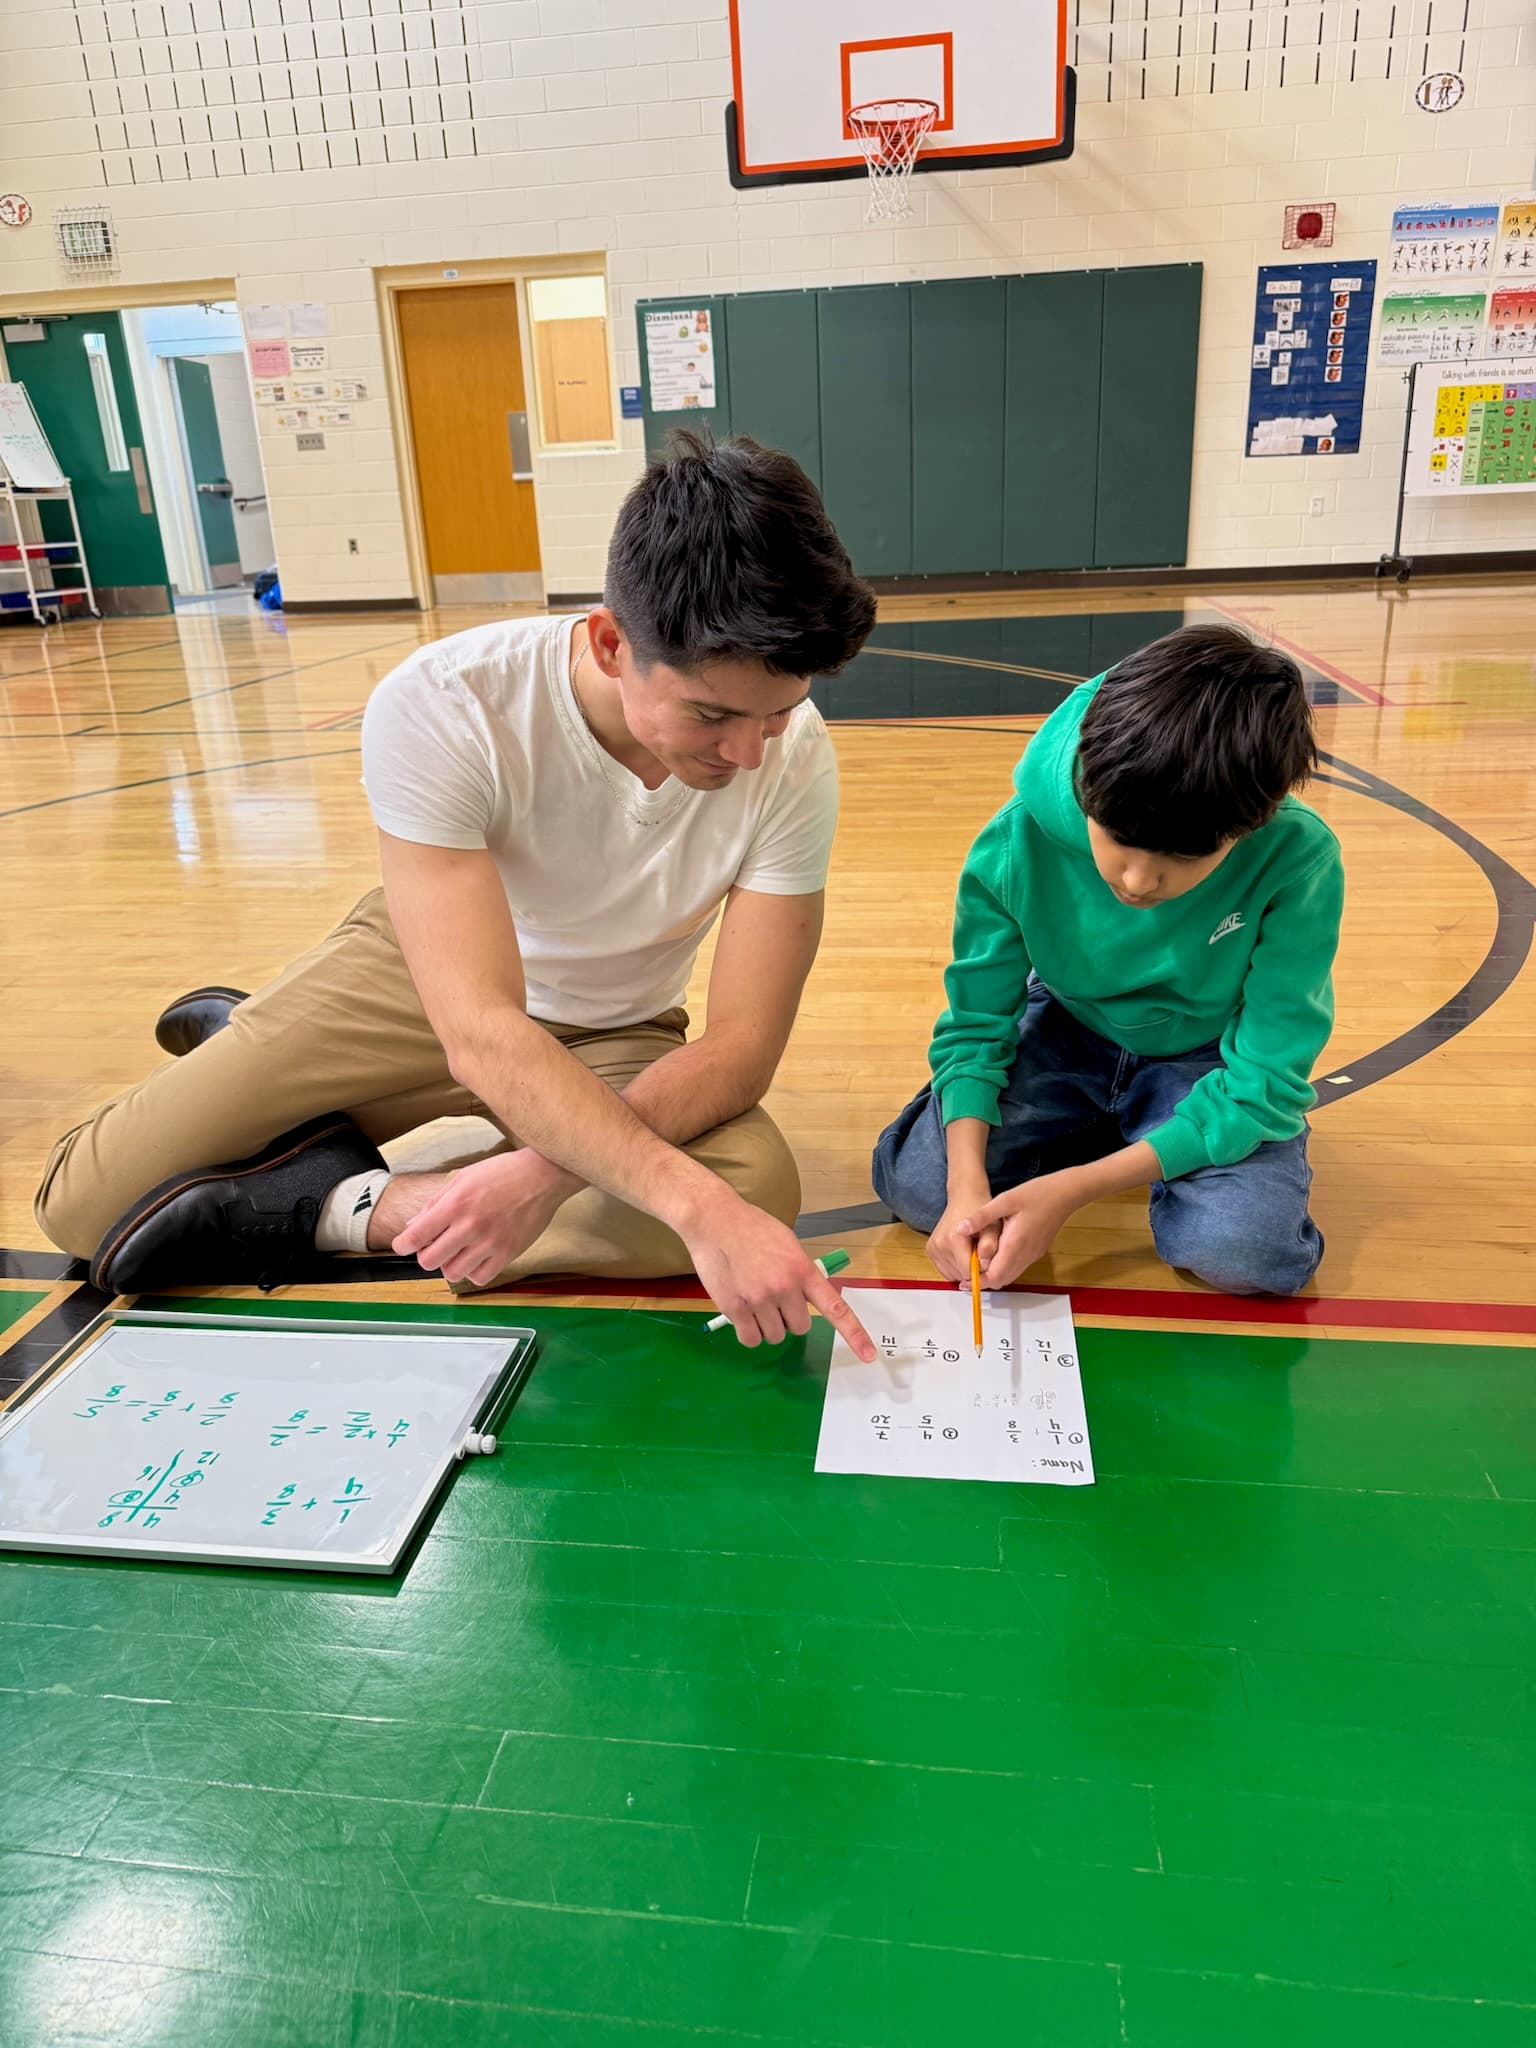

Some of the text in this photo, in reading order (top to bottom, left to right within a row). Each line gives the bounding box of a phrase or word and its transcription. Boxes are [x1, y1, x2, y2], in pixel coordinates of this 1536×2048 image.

[18, 203, 26, 222] F
[645, 311, 693, 322] Dismissal
[1442, 370, 1462, 380] Talking
[1464, 369, 1476, 378] with
[1517, 367, 1534, 375] much
[881, 1335, 897, 1345] 14
[925, 1338, 937, 1347] 7
[1000, 1338, 1010, 1348] 6
[1034, 1339, 1052, 1349] 12
[923, 1350, 937, 1358] 5
[1002, 1352, 1012, 1361] 3
[105, 1384, 128, 1398] 8
[164, 1390, 183, 1402] 8
[288, 1409, 310, 1422] 8
[870, 1414, 892, 1424] 20
[920, 1414, 933, 1425] 5
[393, 1418, 412, 1433] 4
[1007, 1420, 1017, 1429] 8
[1049, 1418, 1061, 1431] 4
[270, 1433, 291, 1447] 2
[875, 1430, 889, 1441] 7
[922, 1430, 933, 1441] 4
[1009, 1433, 1020, 1444] 3
[197, 1450, 221, 1466] 12
[135, 1465, 162, 1481] 16
[277, 1482, 297, 1499] 8
[343, 1476, 364, 1496] 4
[164, 1489, 181, 1504] 4
[142, 1512, 161, 1528] 4
[260, 1507, 282, 1526] 3
[339, 1508, 351, 1524] 1
